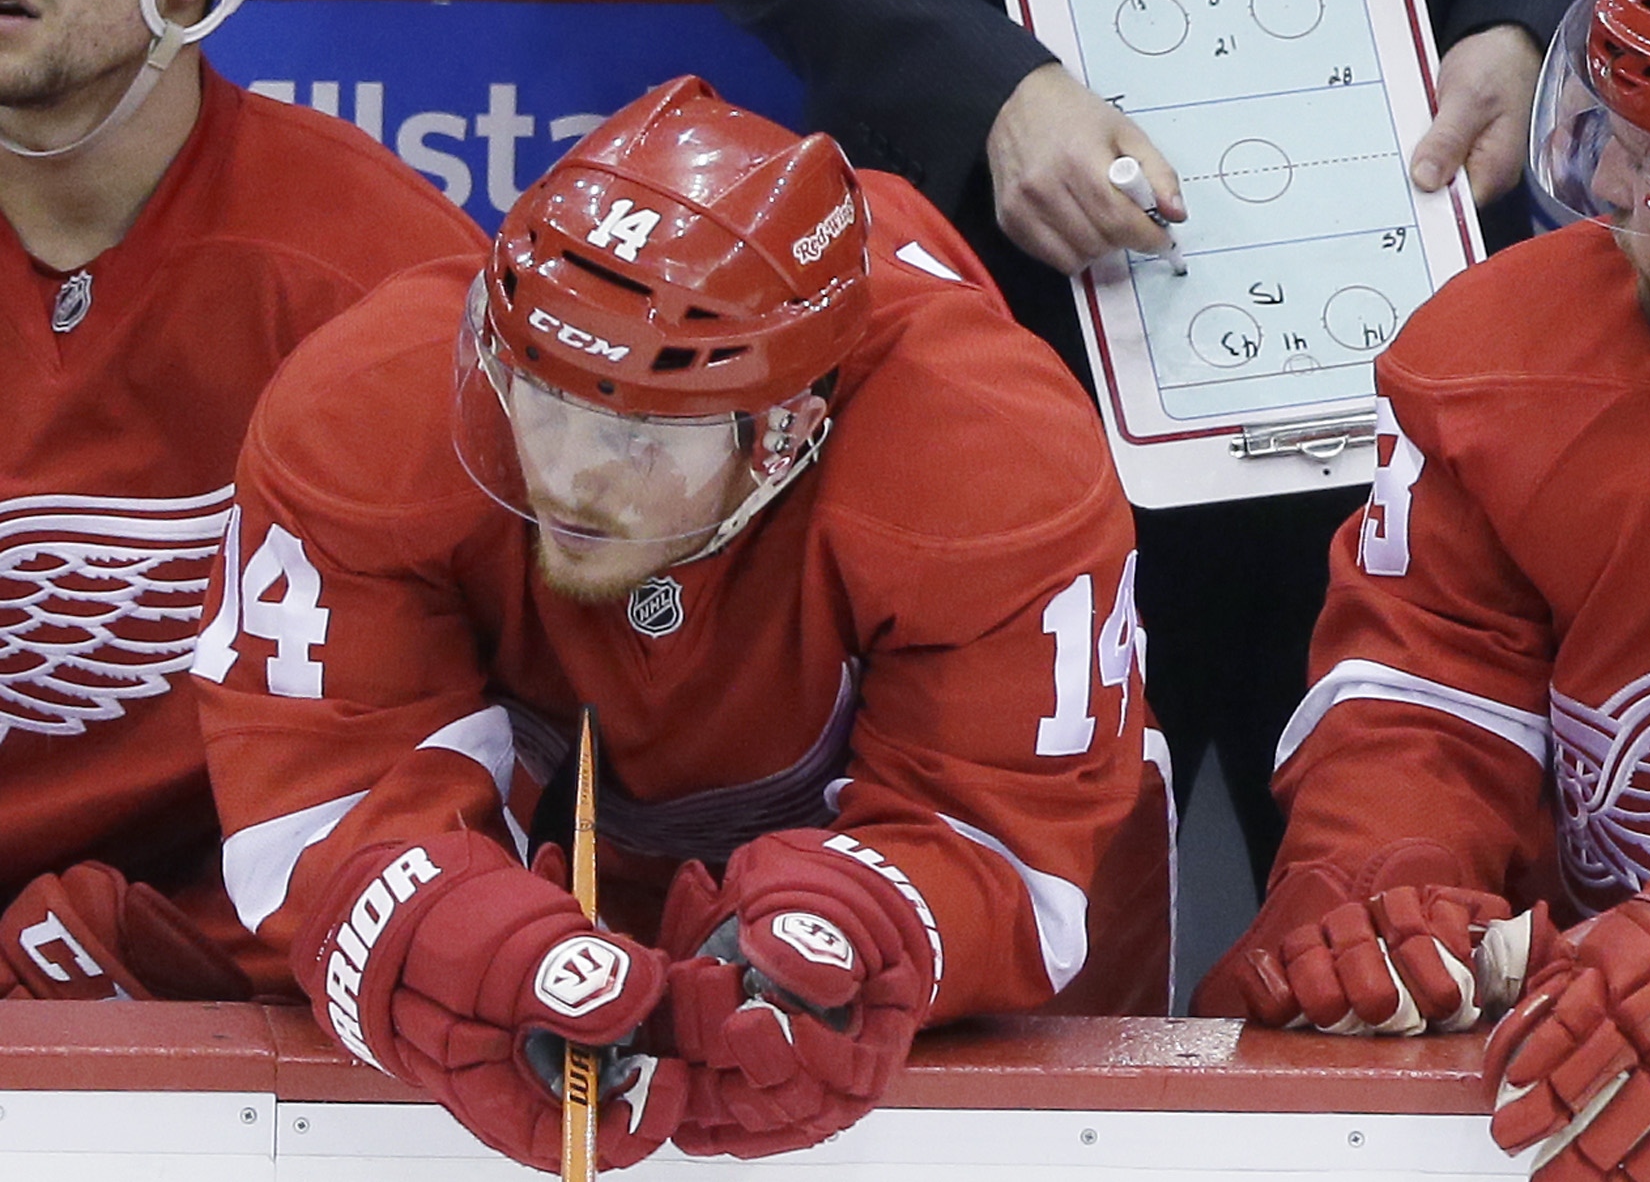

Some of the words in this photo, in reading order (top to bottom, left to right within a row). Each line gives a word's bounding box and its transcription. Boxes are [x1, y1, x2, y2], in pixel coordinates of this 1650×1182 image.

[1214, 35, 1237, 57] 21
[1328, 67, 1353, 85] 28
[587, 199, 661, 262] 14
[794, 222, 831, 265] Red
[528, 307, 630, 362] CCM
[188, 503, 330, 699] 14
[639, 592, 671, 622] NHL
